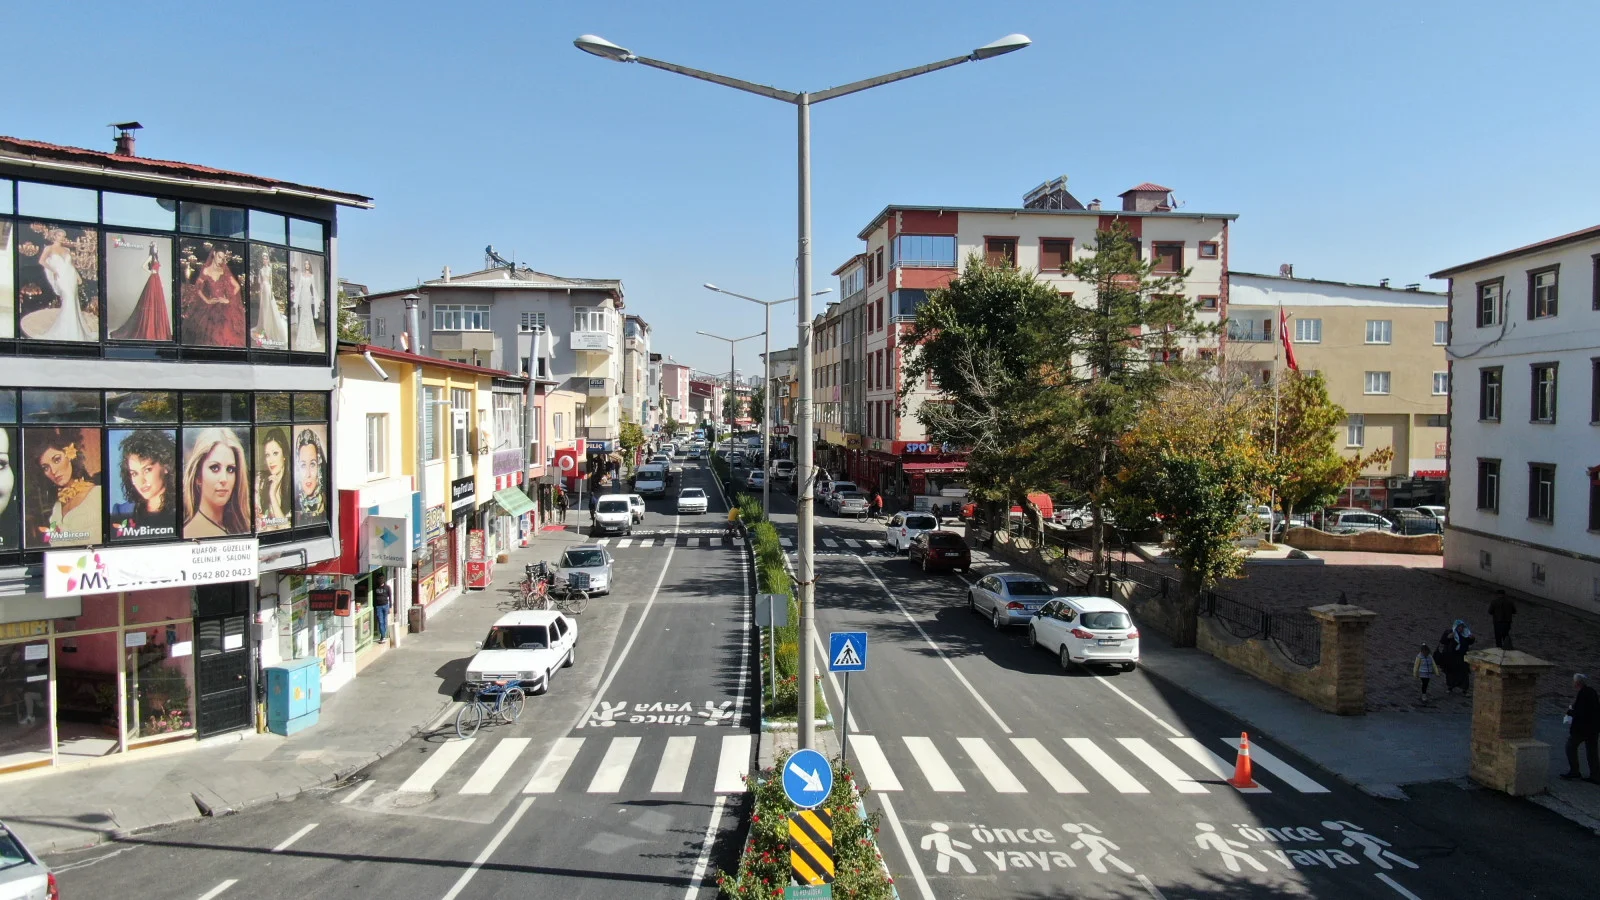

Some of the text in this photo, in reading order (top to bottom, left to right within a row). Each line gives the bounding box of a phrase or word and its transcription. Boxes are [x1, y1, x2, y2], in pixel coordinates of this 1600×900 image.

[906, 443, 933, 453] SPOT
[51, 531, 90, 539] MyBircan
[123, 526, 174, 537] MyBircan
[227, 553, 251, 561] SALONU
[192, 571, 213, 580] 0542
[215, 570, 230, 578] 802
[232, 568, 252, 577] 0423
[634, 701, 693, 711] yaya
[629, 715, 691, 726] önce
[968, 824, 1057, 843] önce
[1231, 823, 1325, 842] önce
[983, 851, 1077, 871] yaya
[1262, 849, 1360, 870] yaya
